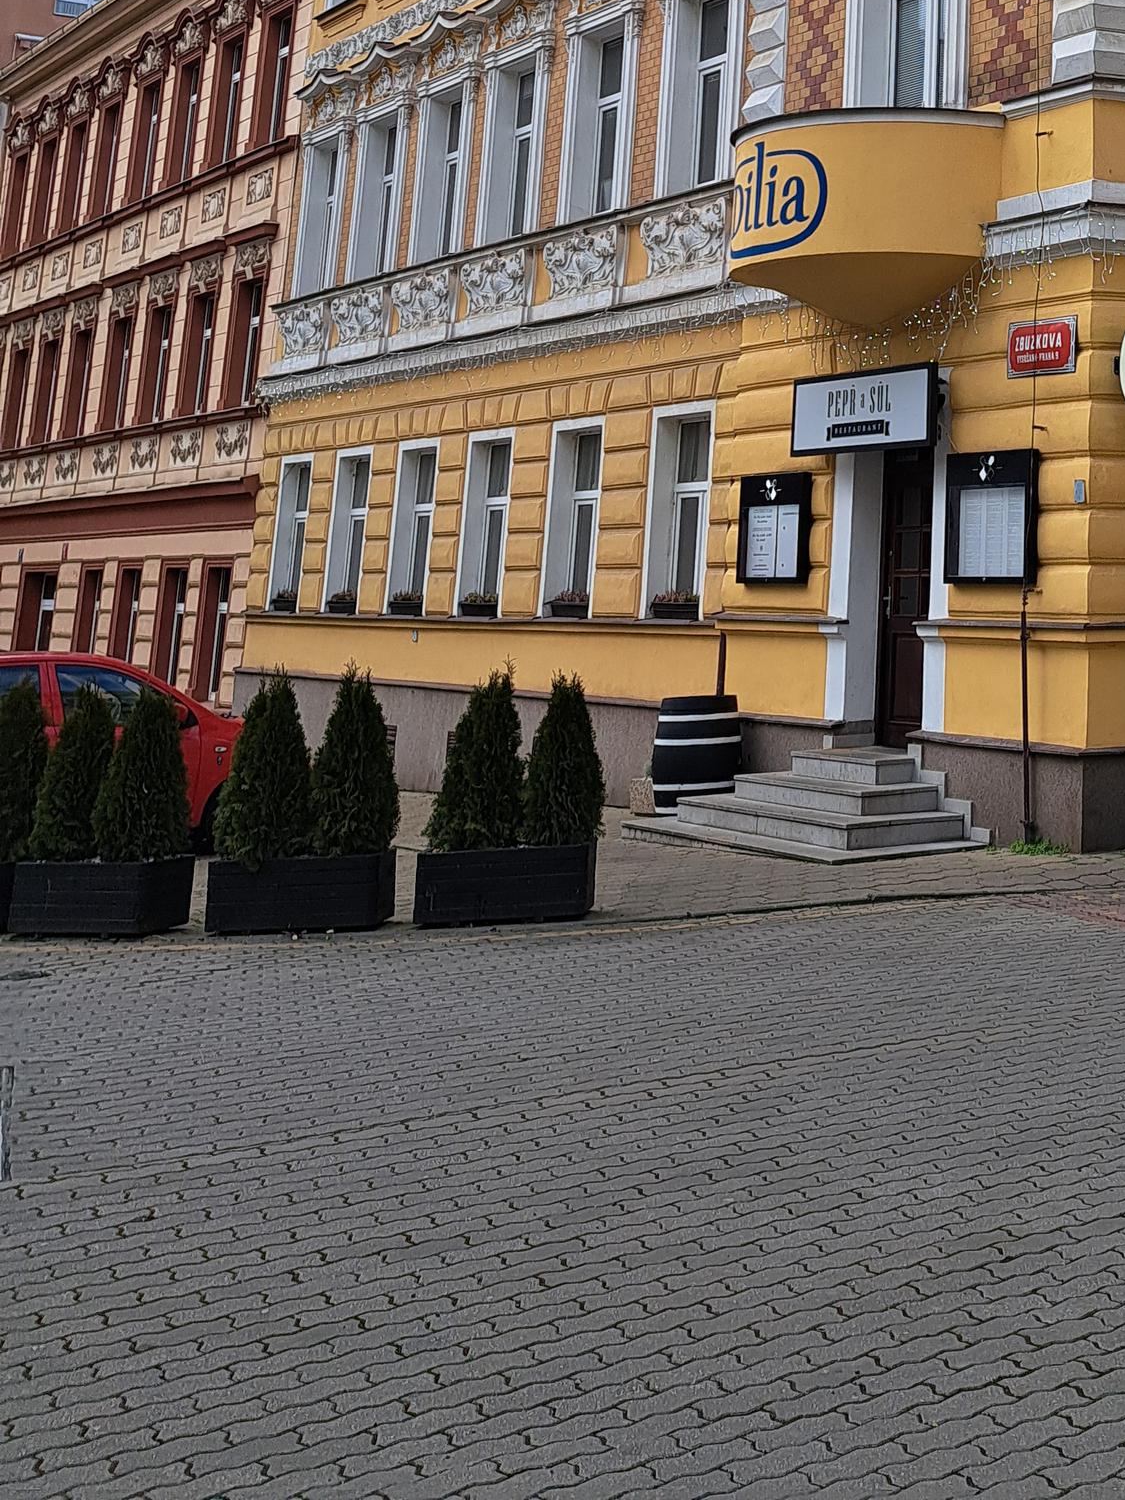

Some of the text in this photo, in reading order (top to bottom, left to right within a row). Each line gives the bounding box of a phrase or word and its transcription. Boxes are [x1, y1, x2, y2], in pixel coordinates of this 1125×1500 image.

[1015, 332, 1062, 352] ZBUZKOVA
[860, 393, 865, 409] a
[869, 381, 891, 414] SŮL
[834, 423, 882, 435] RESTAURANT
